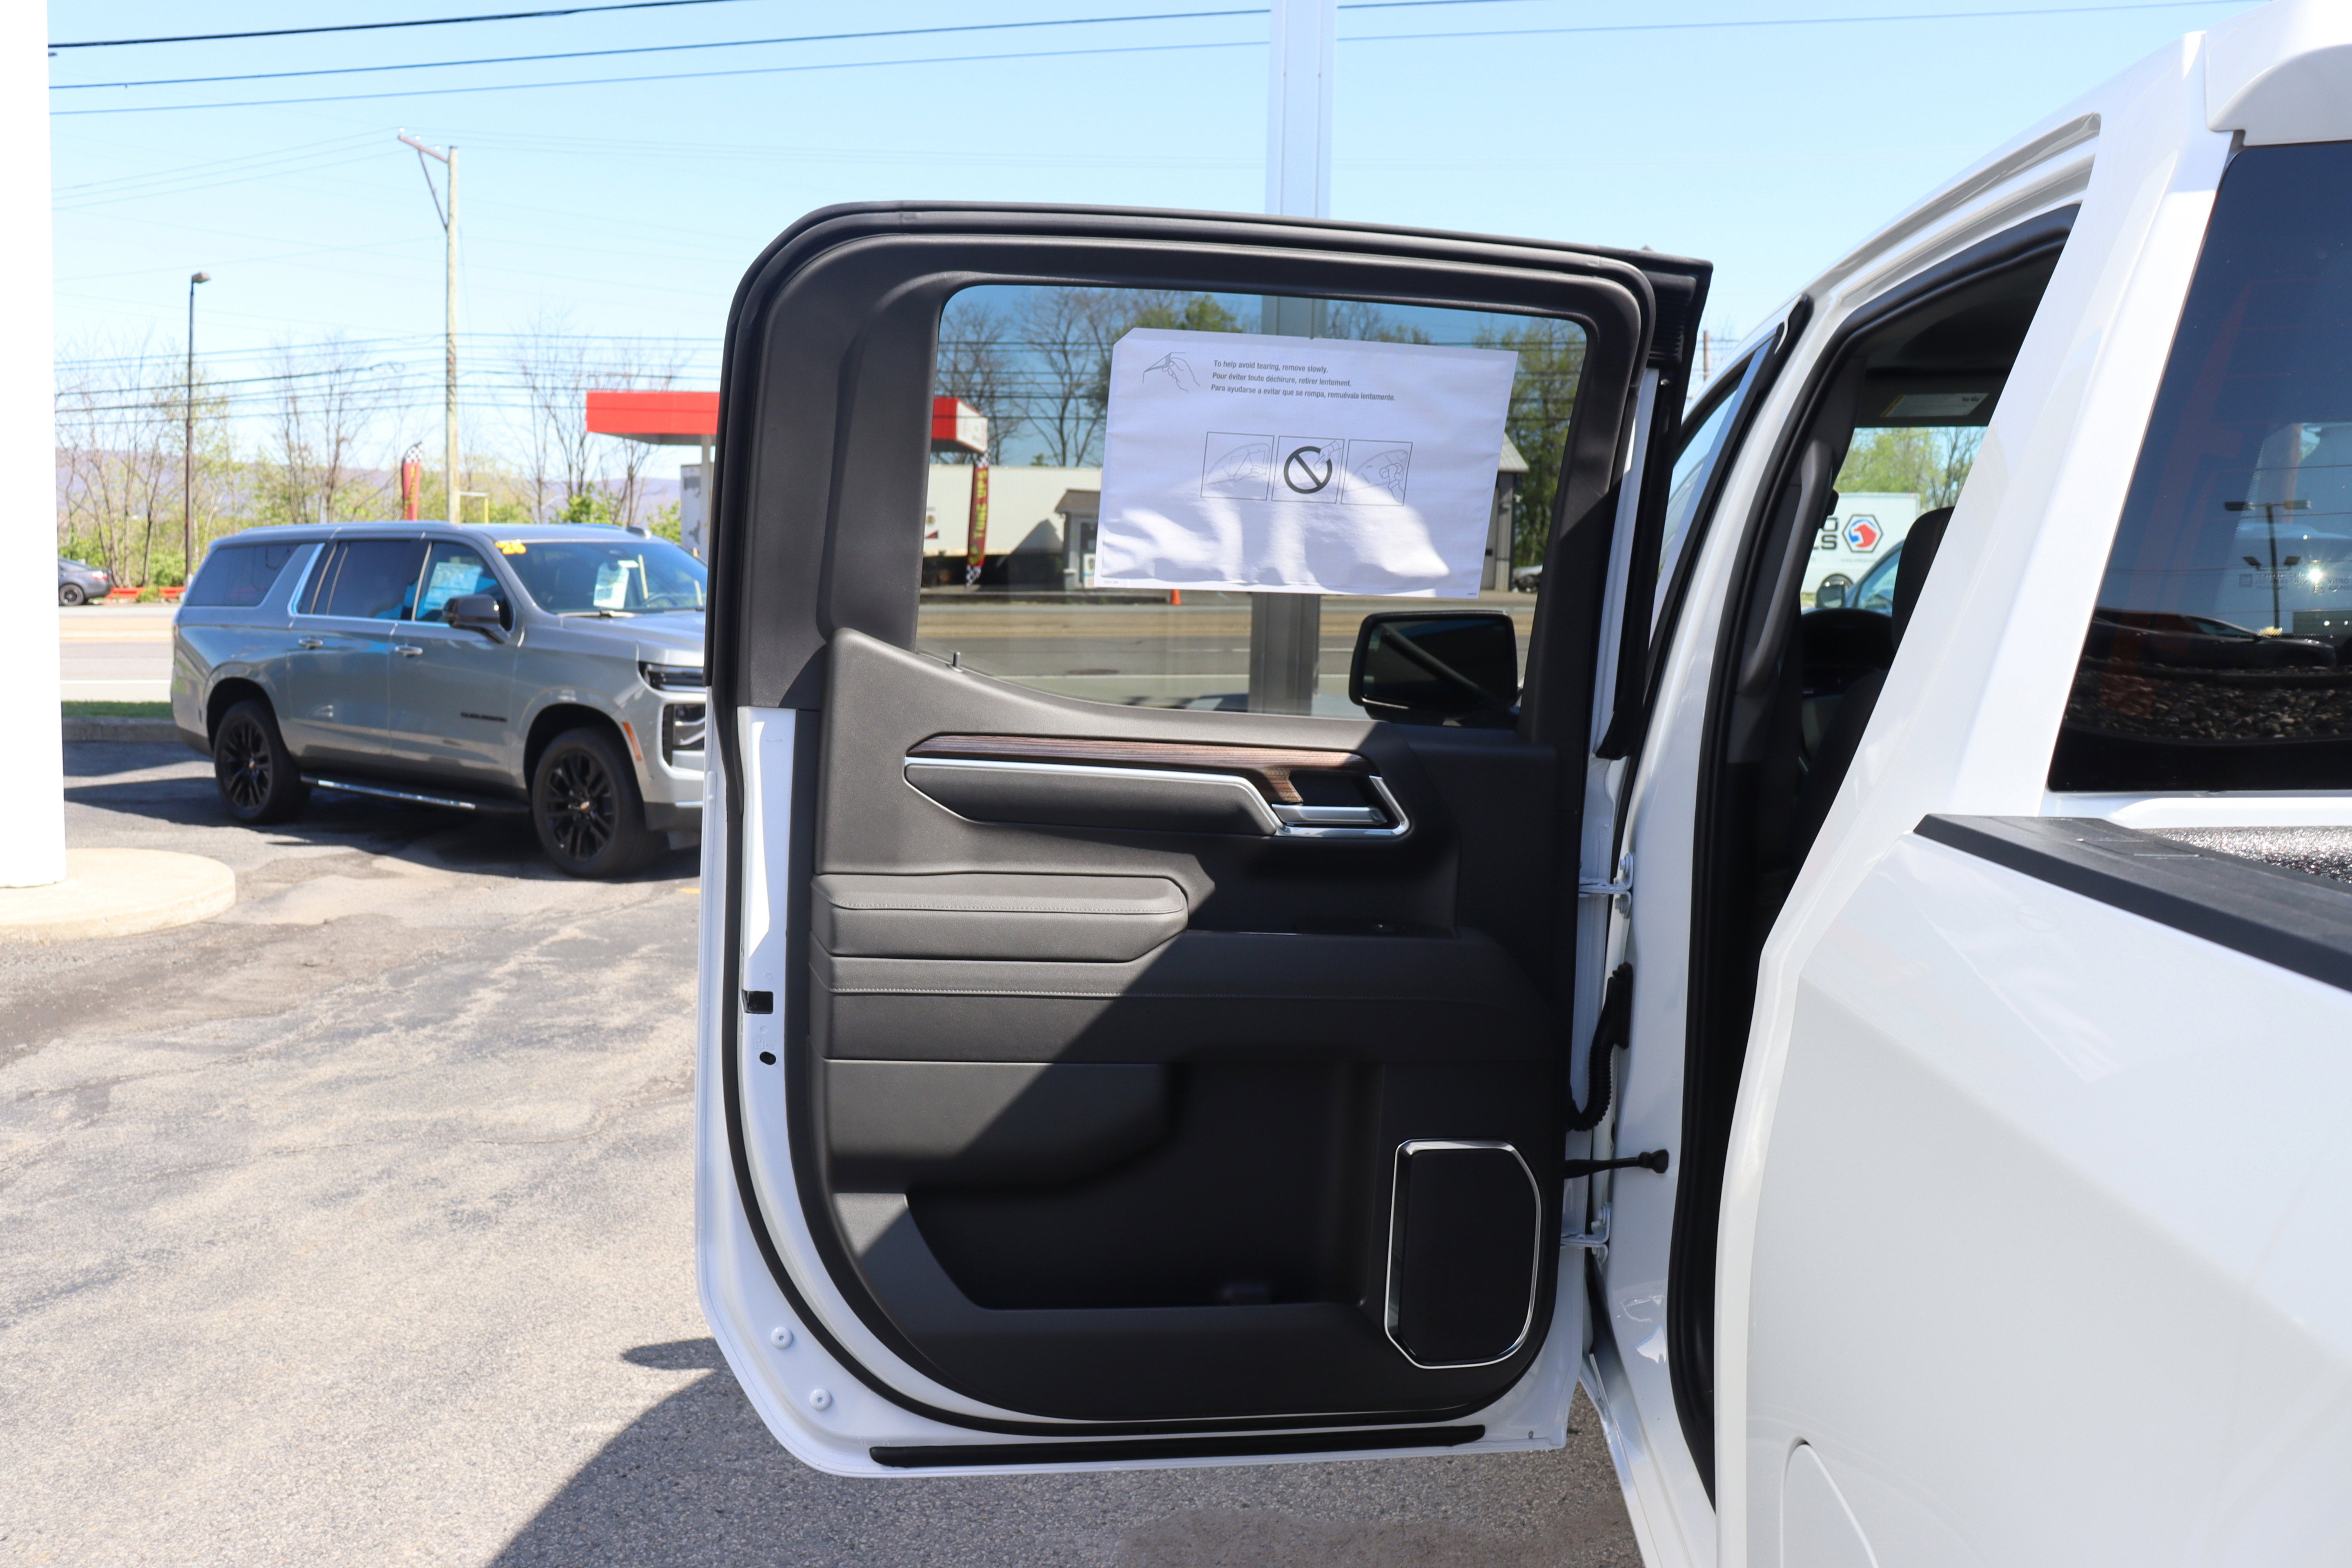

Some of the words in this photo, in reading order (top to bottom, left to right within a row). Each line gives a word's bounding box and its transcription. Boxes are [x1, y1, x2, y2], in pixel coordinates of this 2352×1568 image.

[1223, 360, 1236, 369] help
[1257, 362, 1280, 372] tearing,
[1307, 365, 1328, 374] slowly.
[1228, 372, 1246, 381] éviter
[1266, 375, 1297, 385] déchirure,
[1319, 378, 1352, 387] lentement.
[1227, 385, 1256, 394] ayudarse
[1360, 393, 1396, 401] lentamente.
[976, 470, 988, 499] UPS
